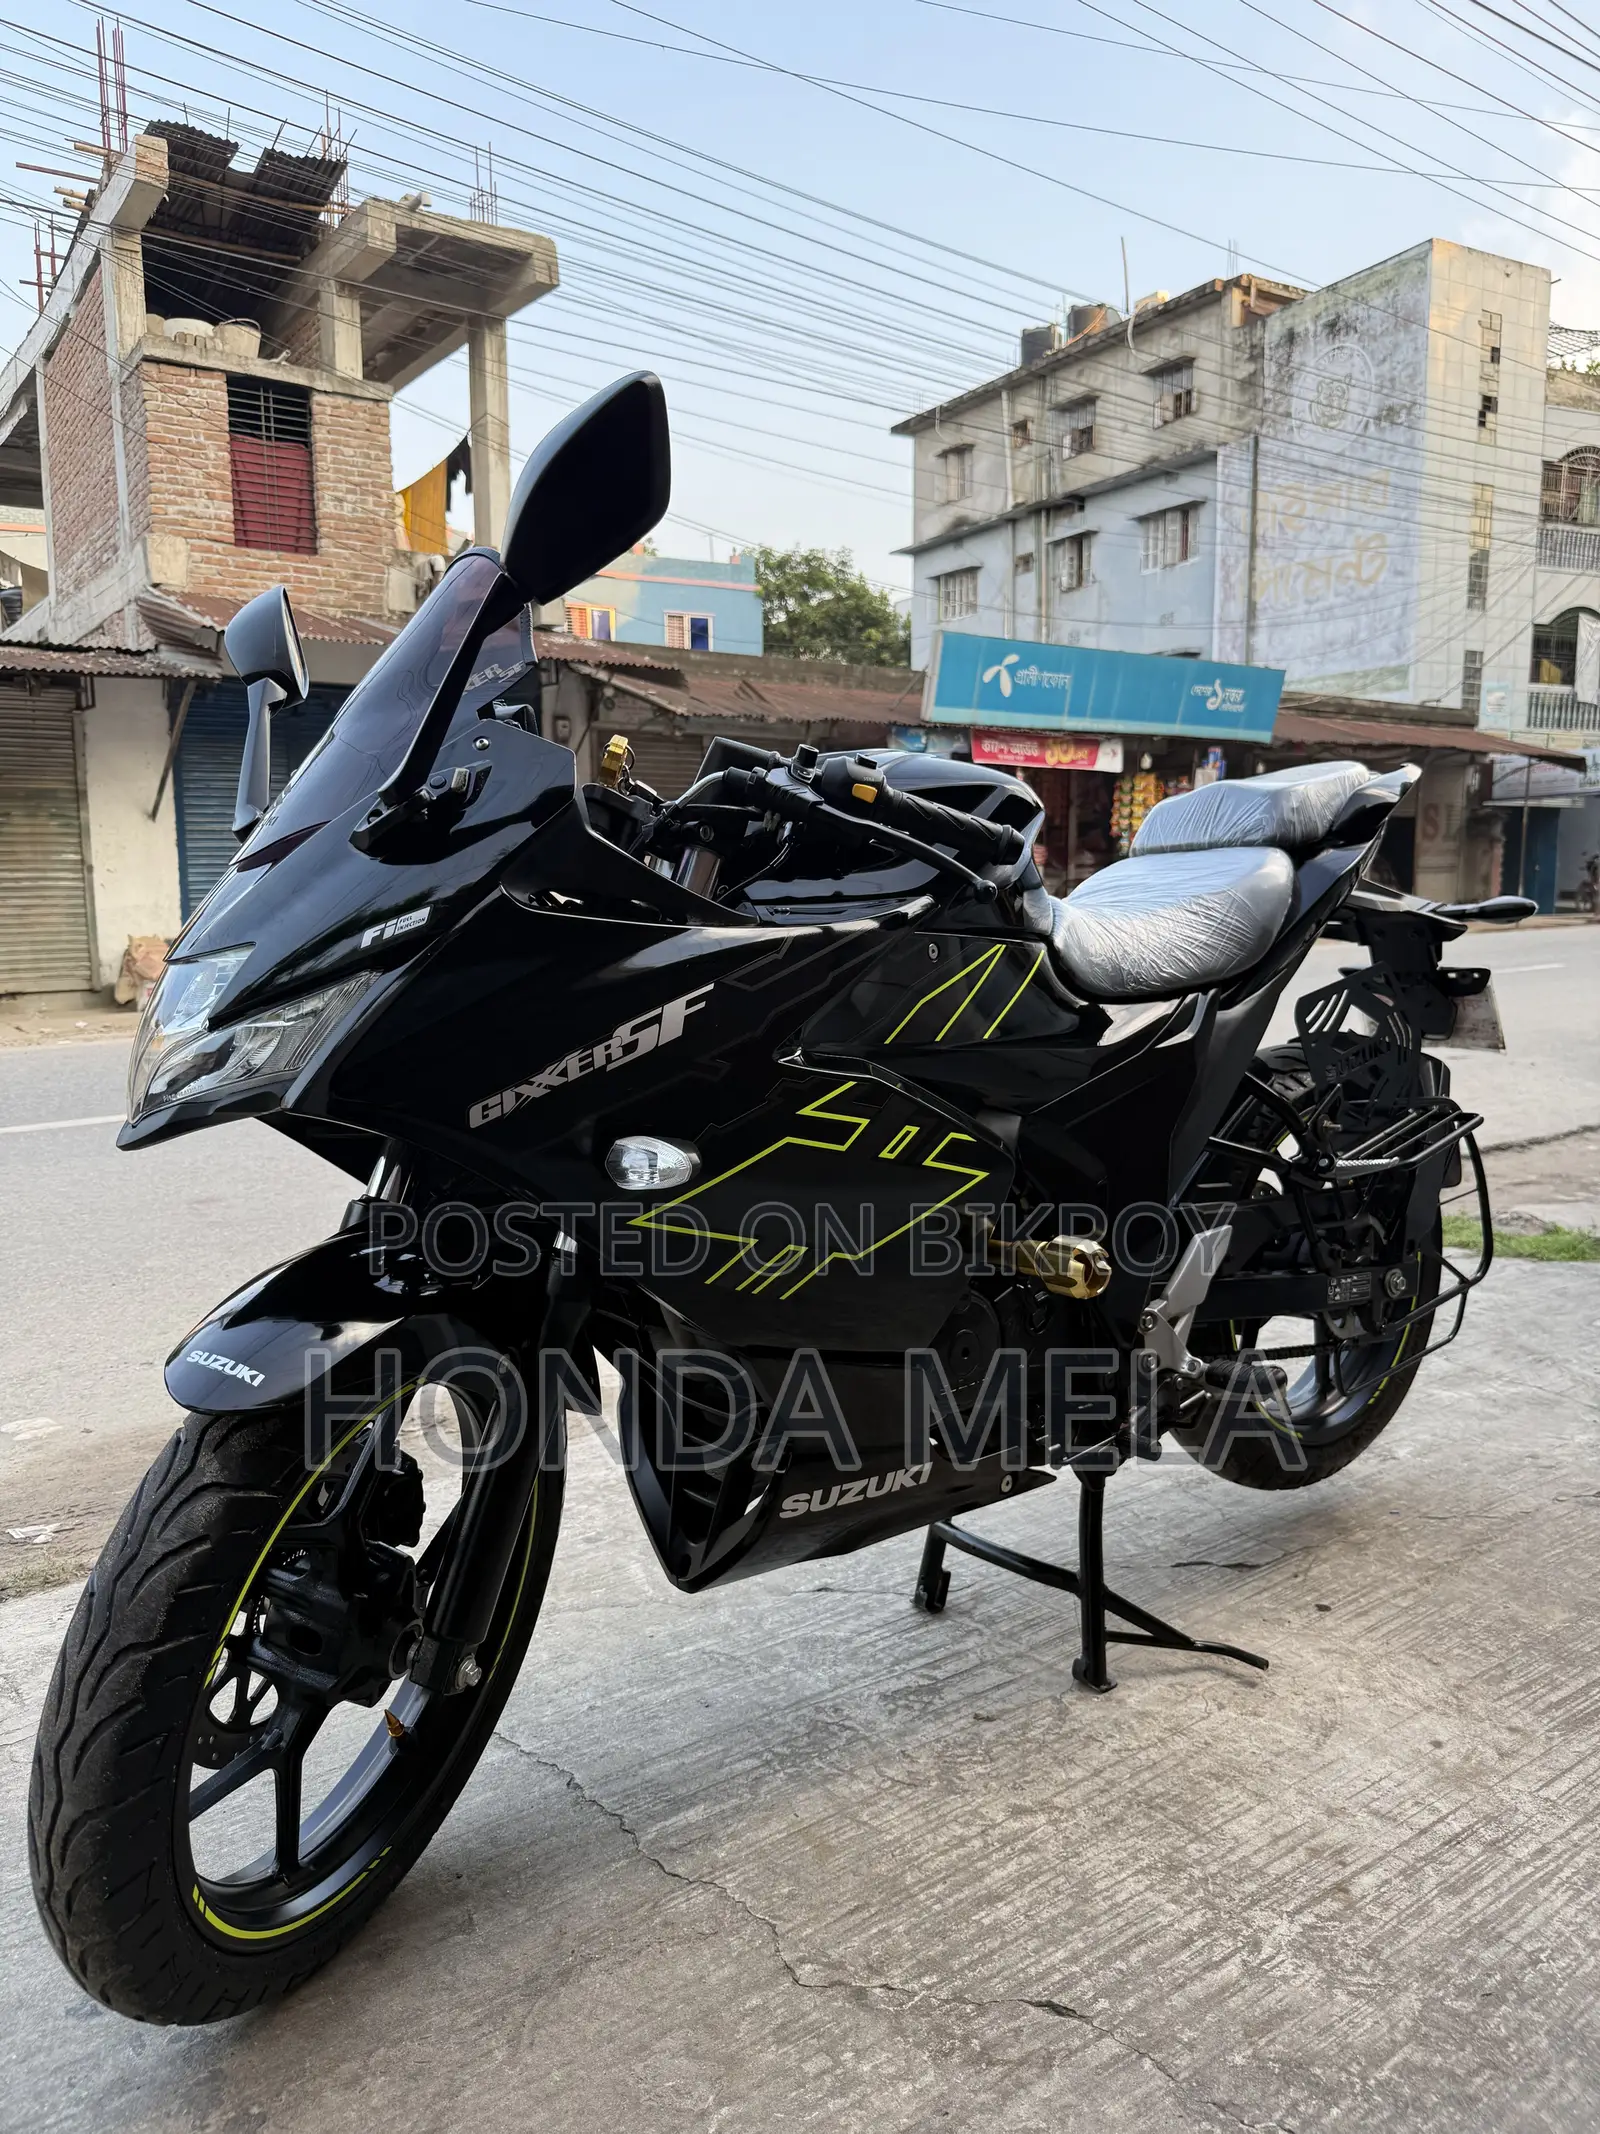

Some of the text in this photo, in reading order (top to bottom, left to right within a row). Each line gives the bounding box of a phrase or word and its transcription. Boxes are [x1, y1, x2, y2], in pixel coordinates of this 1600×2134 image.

[397, 916, 426, 932] INJECTION
[186, 1350, 266, 1387] SUZUKI
[779, 1461, 933, 1519] SUZUKI
